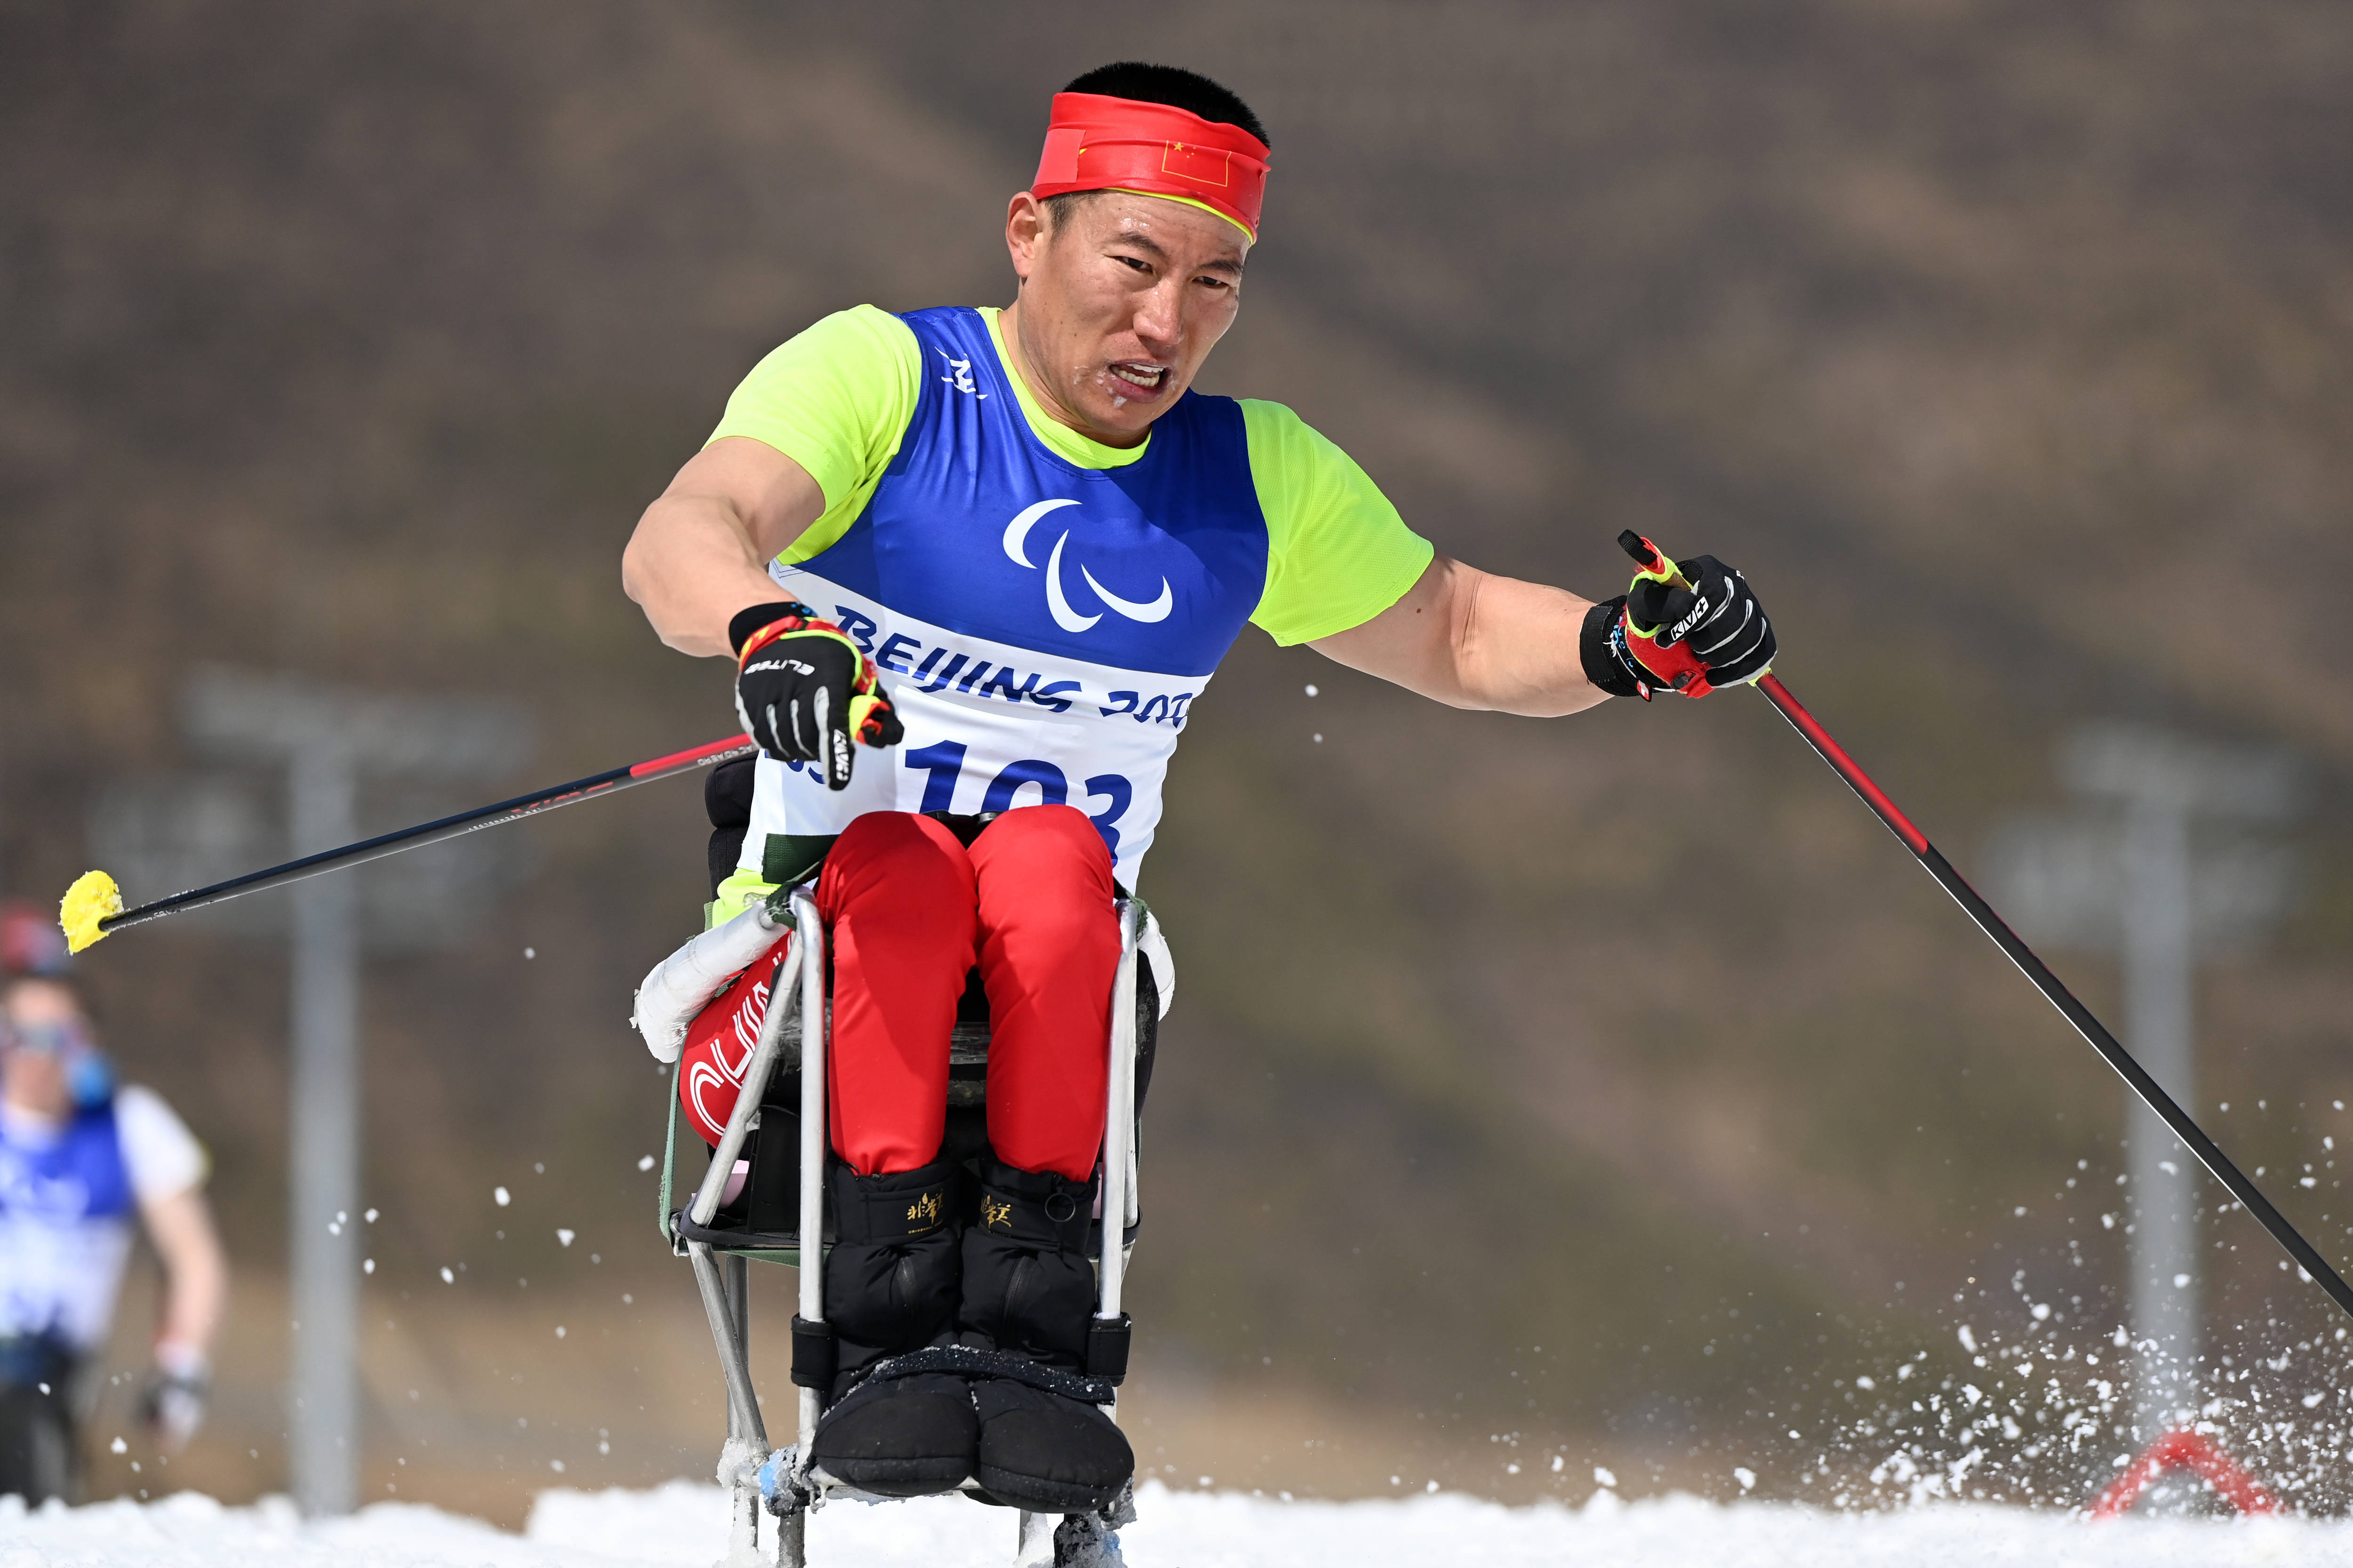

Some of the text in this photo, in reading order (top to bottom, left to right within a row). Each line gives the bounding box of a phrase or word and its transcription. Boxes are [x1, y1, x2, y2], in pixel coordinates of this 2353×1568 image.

[835, 605, 1193, 728] BEIJING 202
[468, 814, 521, 831] TECHNOLOGY
